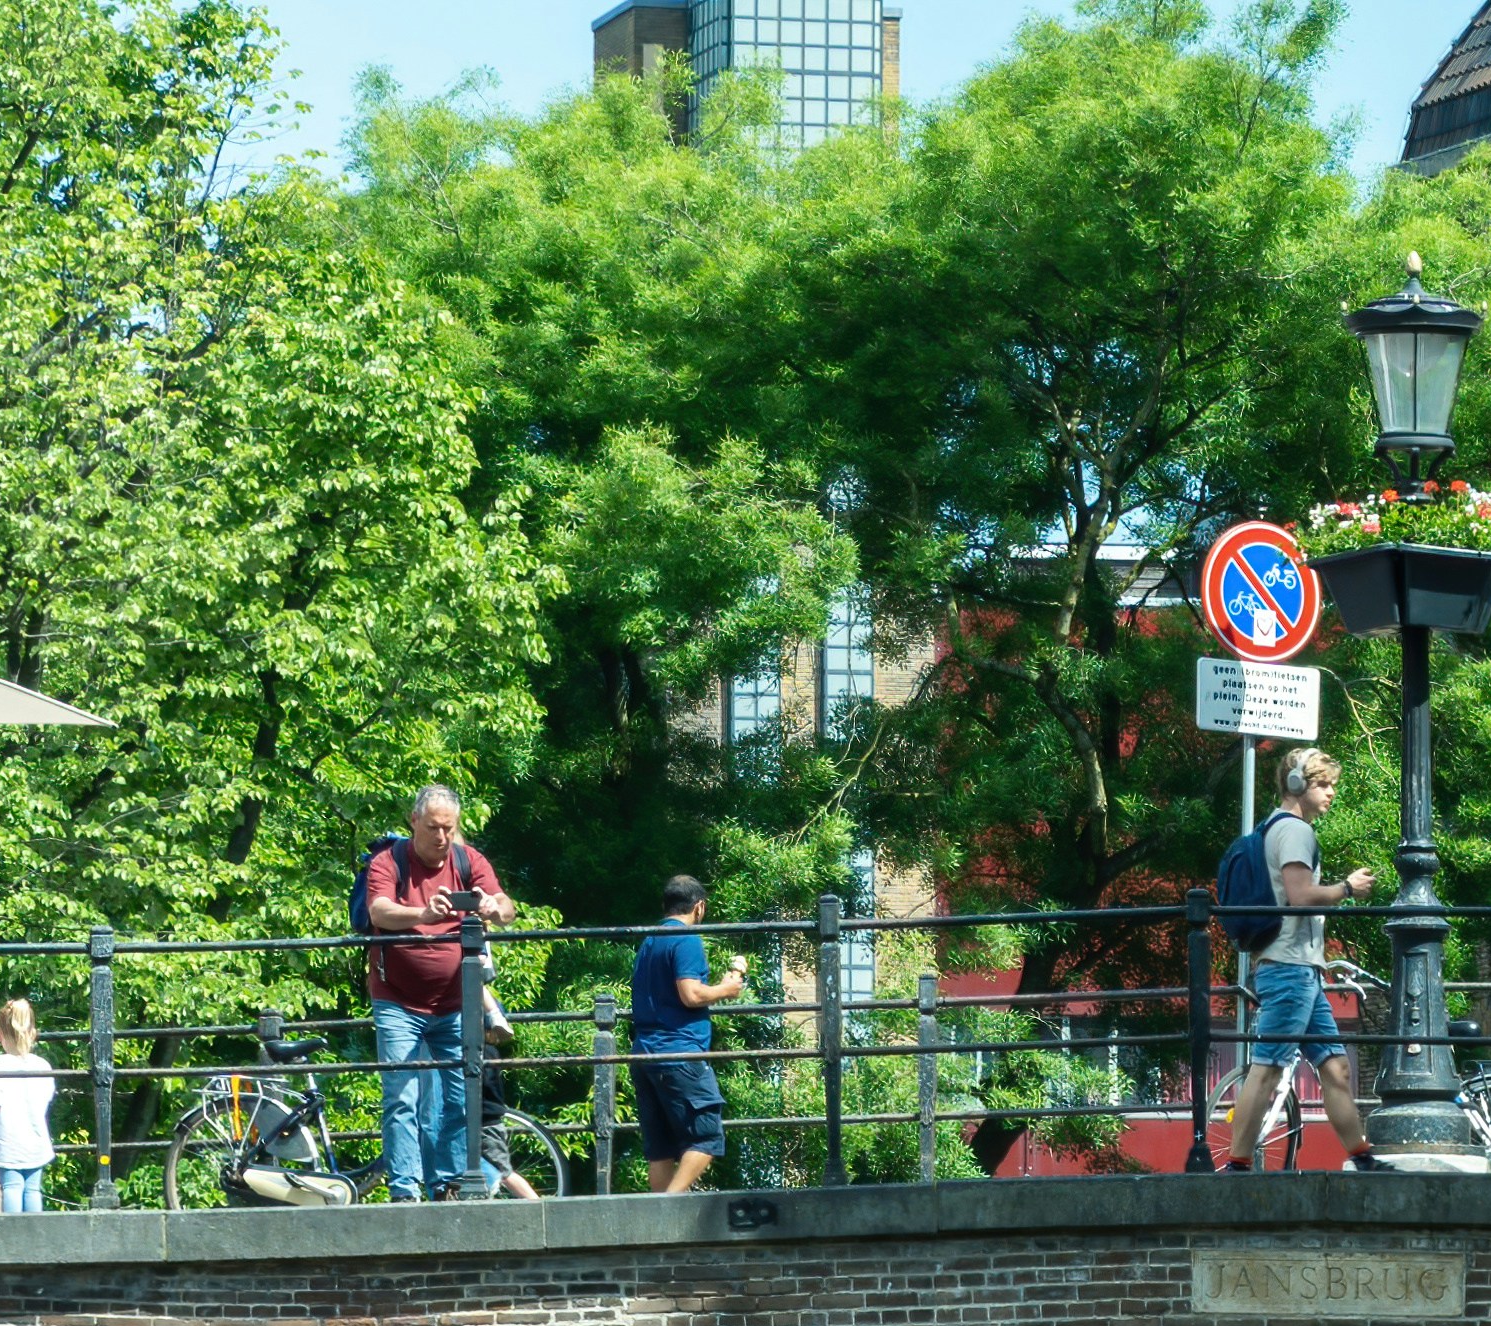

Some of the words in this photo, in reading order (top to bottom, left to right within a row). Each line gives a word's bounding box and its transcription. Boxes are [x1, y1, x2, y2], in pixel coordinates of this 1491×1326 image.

[1213, 665, 1237, 675] geen
[1222, 678, 1265, 690] plaatsen
[1267, 685, 1279, 693] op
[1282, 685, 1298, 694] het
[1245, 693, 1268, 704] Deze
[1273, 699, 1306, 709] worden
[1205, 1263, 1450, 1301] JANSBRUG
